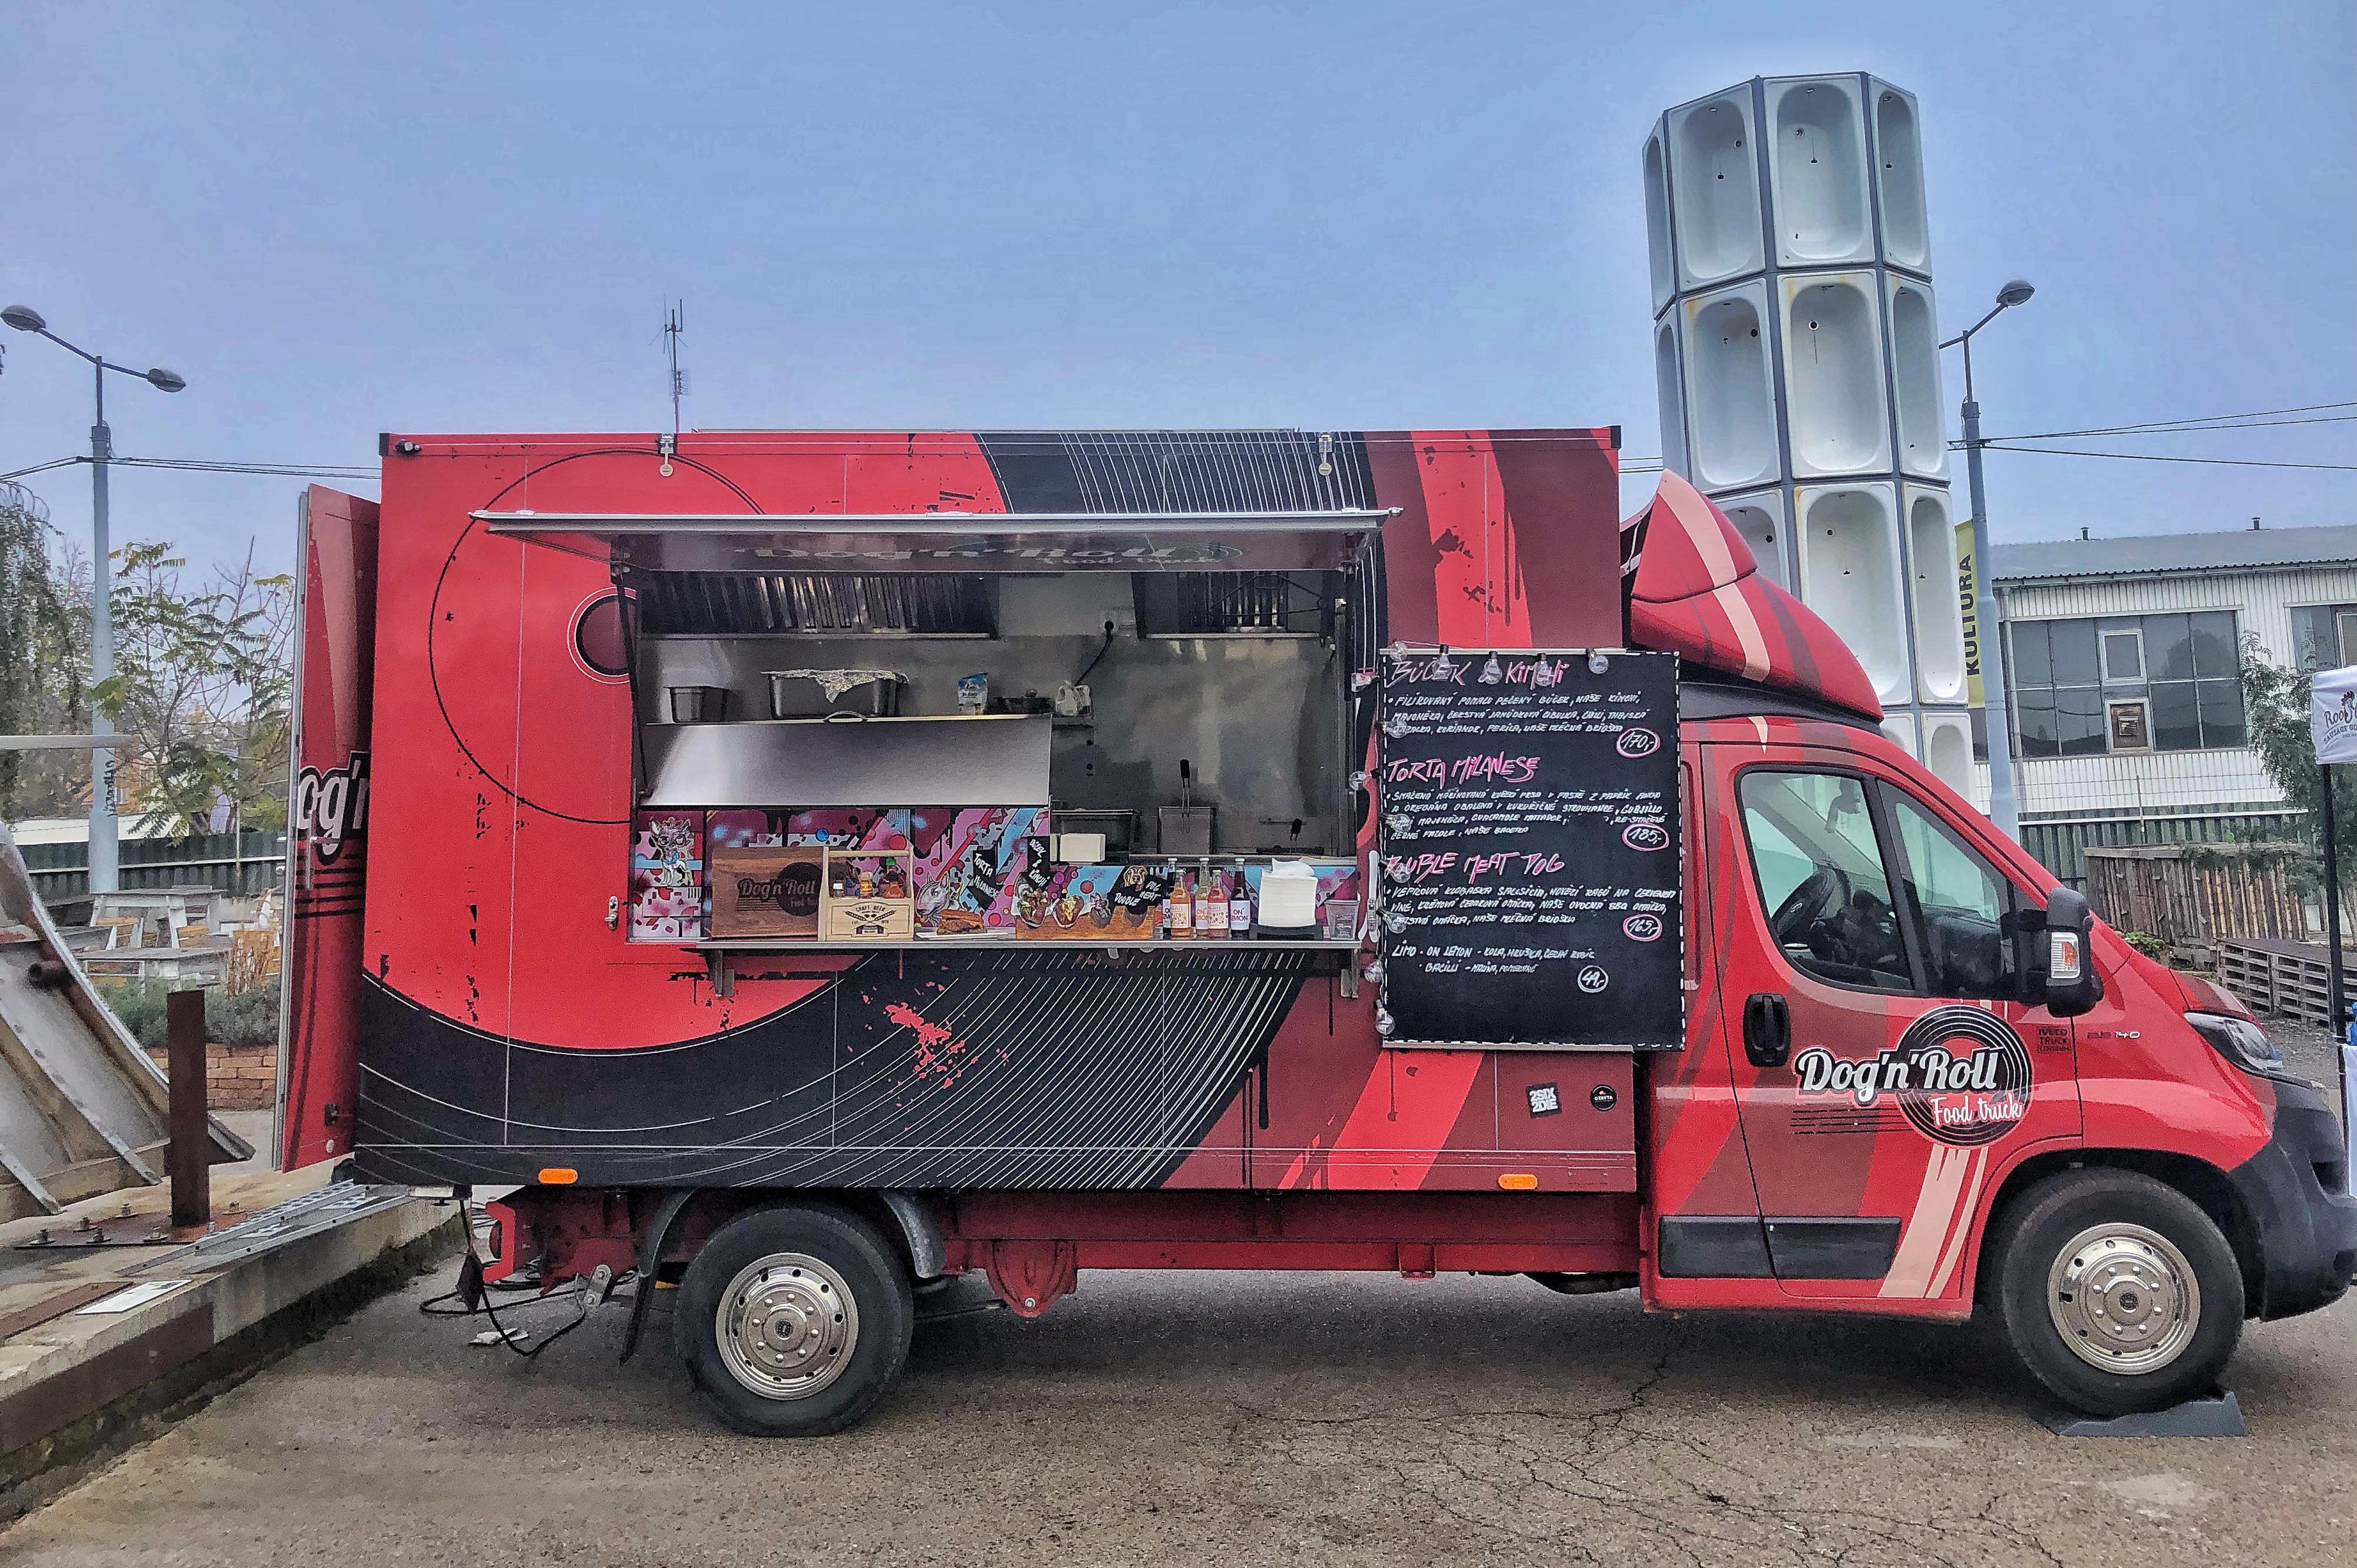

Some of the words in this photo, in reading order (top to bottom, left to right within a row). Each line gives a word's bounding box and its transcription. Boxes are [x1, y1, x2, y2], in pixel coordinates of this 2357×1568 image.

[2323, 725, 2348, 744] SAUSAGE
[1388, 758, 1446, 790] TORTA
[973, 853, 993, 877] TORTA
[1463, 852, 1520, 884] MEAT
[1521, 853, 1566, 876] DOG
[1427, 946, 1441, 957] ON
[1798, 1051, 1998, 1102] Dog'n'Roll
[1930, 1096, 1973, 1125] Food
[1978, 1092, 2022, 1120] truck
